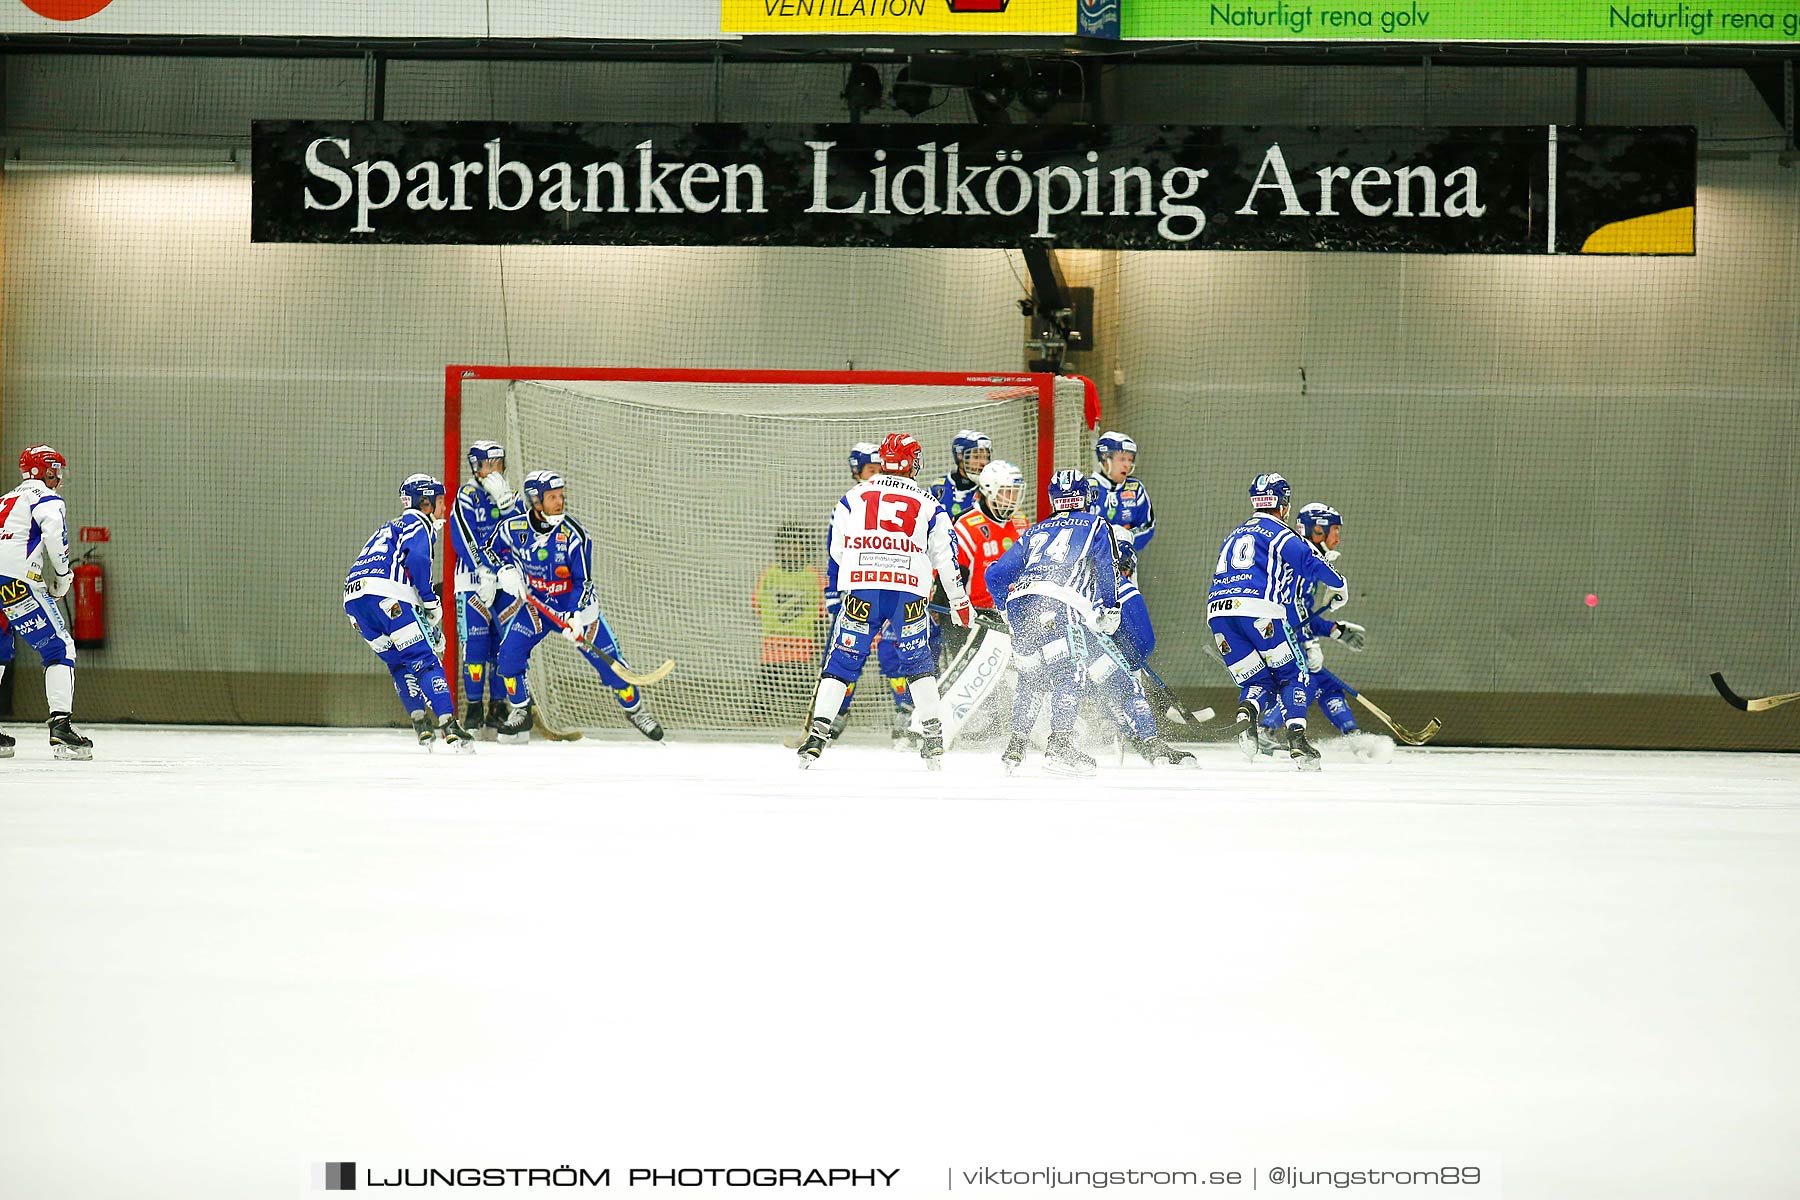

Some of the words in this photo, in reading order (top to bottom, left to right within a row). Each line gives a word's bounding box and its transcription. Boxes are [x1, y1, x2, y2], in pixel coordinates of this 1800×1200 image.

[1211, 1, 1312, 33] Naturligt
[1322, 11, 1372, 26] rena
[1381, 1, 1430, 33] golv
[1610, 2, 1713, 35] Naturligt
[1722, 14, 1774, 28] rena
[303, 137, 768, 234] Sparbanken
[804, 141, 1209, 242] Lidköping
[1235, 143, 1486, 219] Arena
[475, 508, 486, 522] 12
[860, 491, 921, 537] 13
[983, 540, 999, 557] 88
[1025, 528, 1073, 569] 24
[1215, 533, 1256, 575] 10
[847, 596, 870, 618] YVS
[1210, 599, 1233, 613] MVB
[958, 647, 1003, 699] ViaCon
